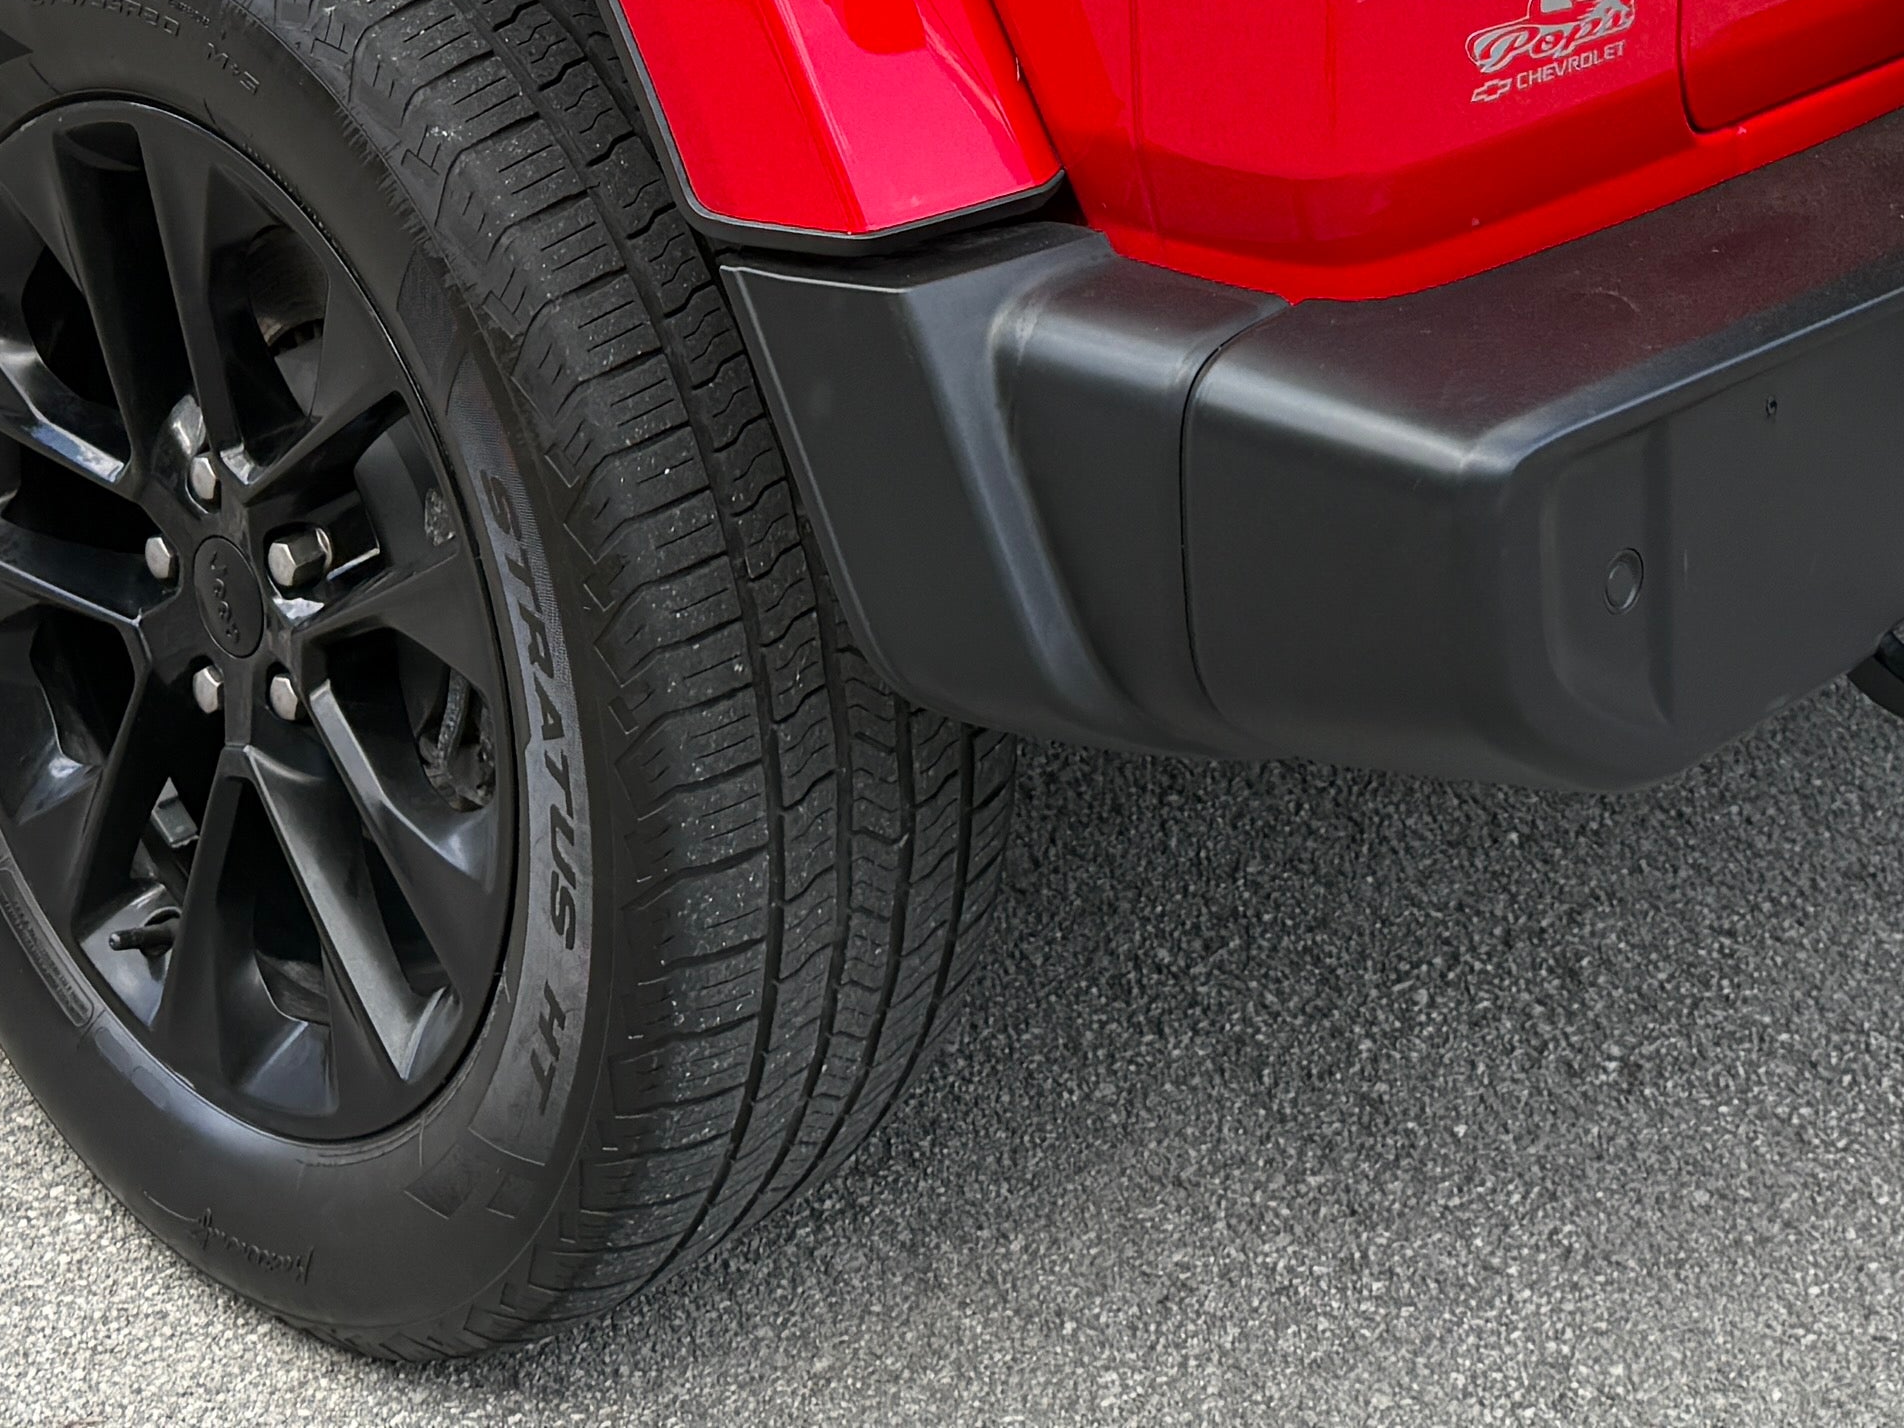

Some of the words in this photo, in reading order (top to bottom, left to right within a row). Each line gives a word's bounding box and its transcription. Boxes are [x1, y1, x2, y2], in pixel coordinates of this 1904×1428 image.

[1516, 40, 1627, 91] CHEVROLET
[207, 549, 242, 646] Jeep
[480, 469, 578, 954] STRATUS
[529, 977, 569, 1116] HT
